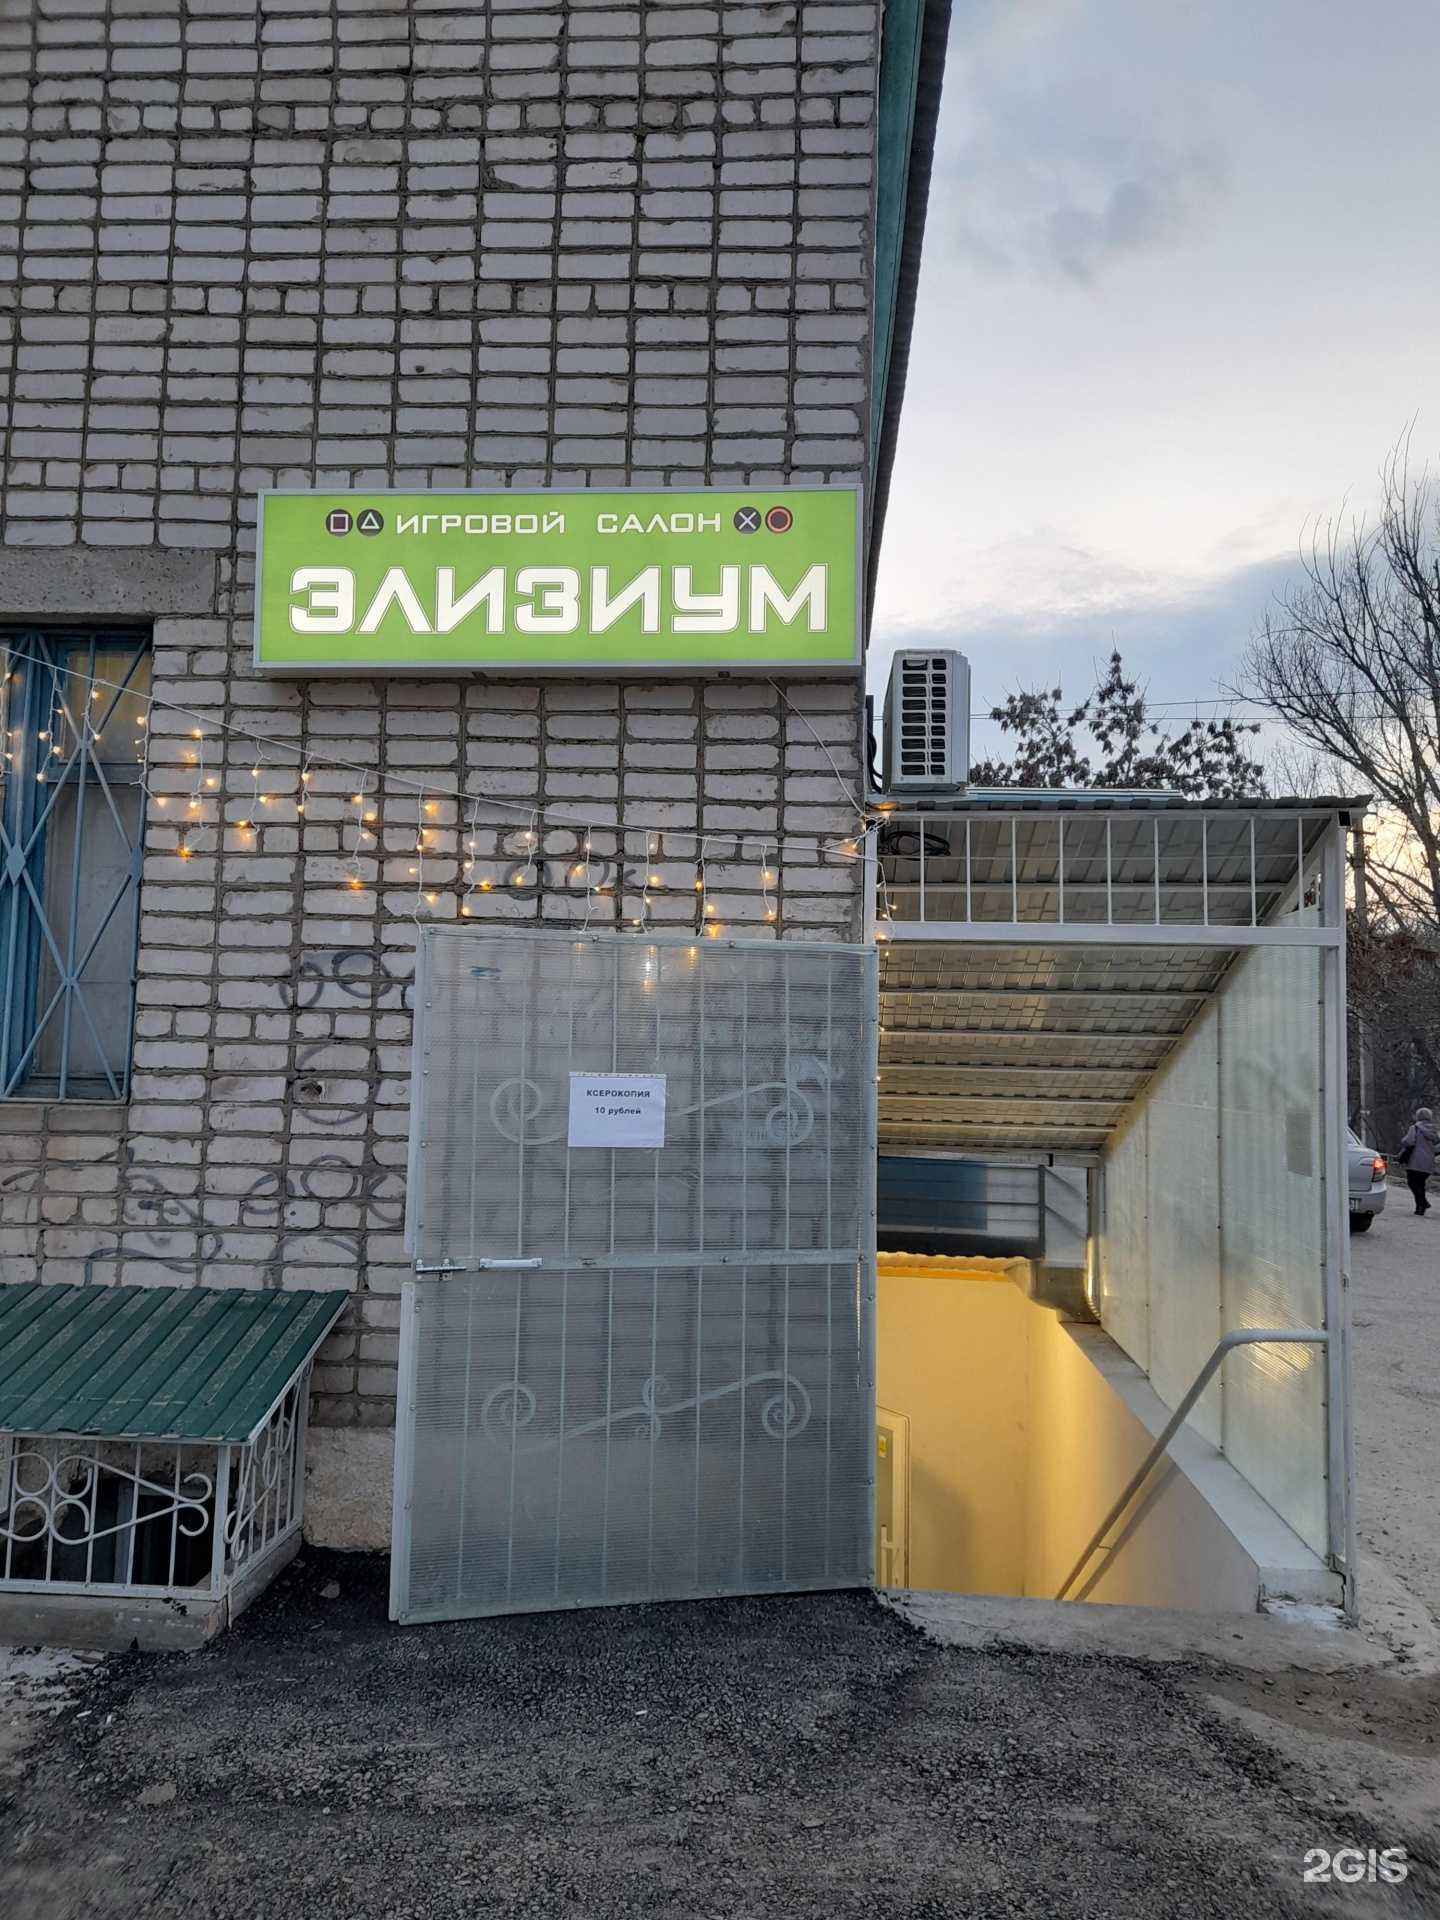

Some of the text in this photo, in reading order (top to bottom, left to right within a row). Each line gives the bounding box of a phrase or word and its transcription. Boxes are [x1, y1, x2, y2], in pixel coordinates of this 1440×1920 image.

[395, 510, 722, 535] ИГРОВОЙ САЛОН
[288, 562, 830, 635] ЭЛИЗИУМ
[586, 1089, 651, 1098] КСЕРОКОПИЯ
[608, 1106, 641, 1116] рублей
